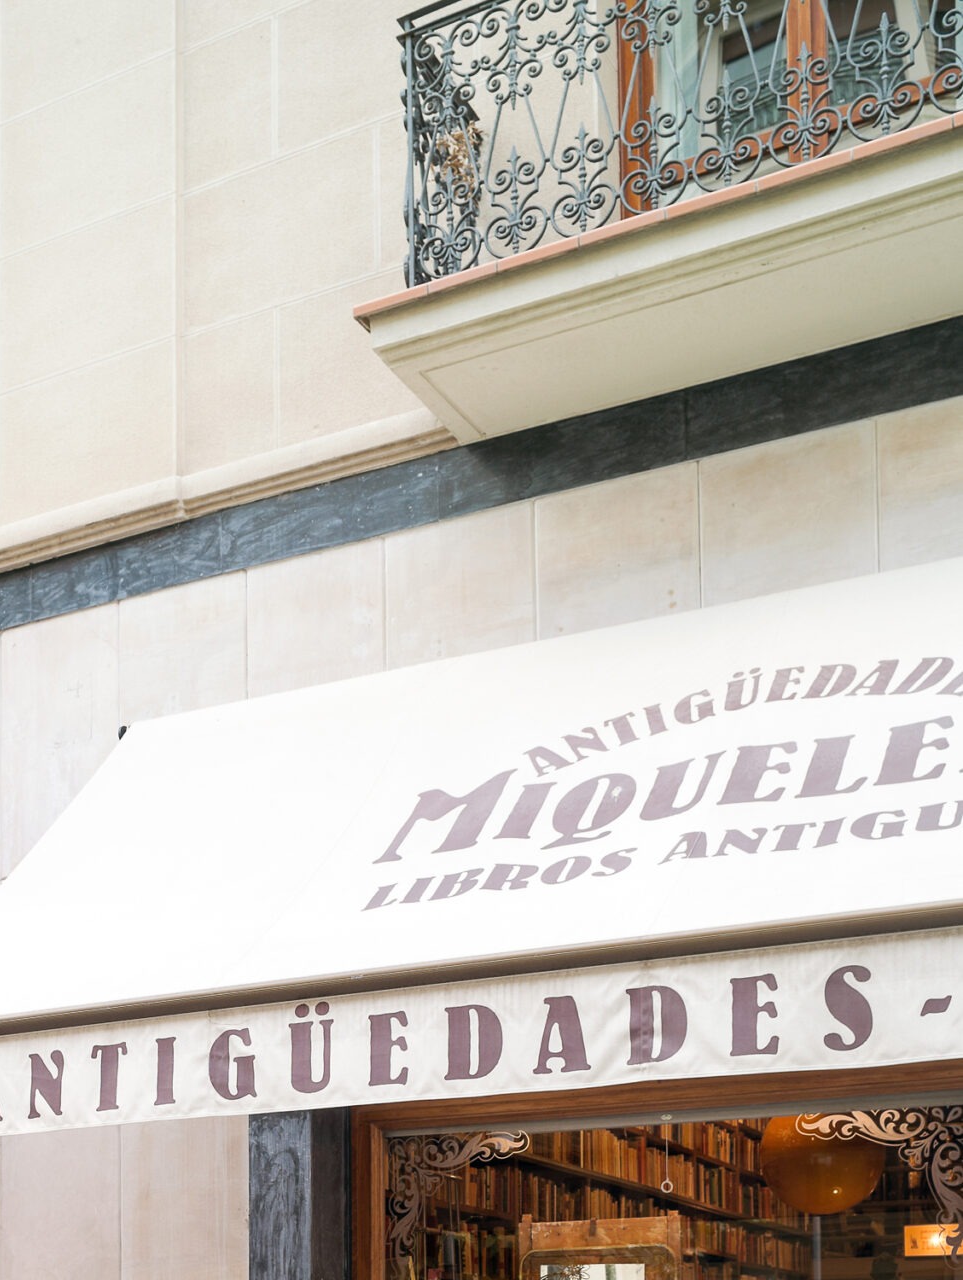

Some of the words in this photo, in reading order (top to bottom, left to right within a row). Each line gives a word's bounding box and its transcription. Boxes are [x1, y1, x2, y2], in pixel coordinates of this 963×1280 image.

[372, 715, 963, 864] MIQUELE
[360, 847, 638, 912] LIBROS
[657, 799, 963, 865] ANTIGU
